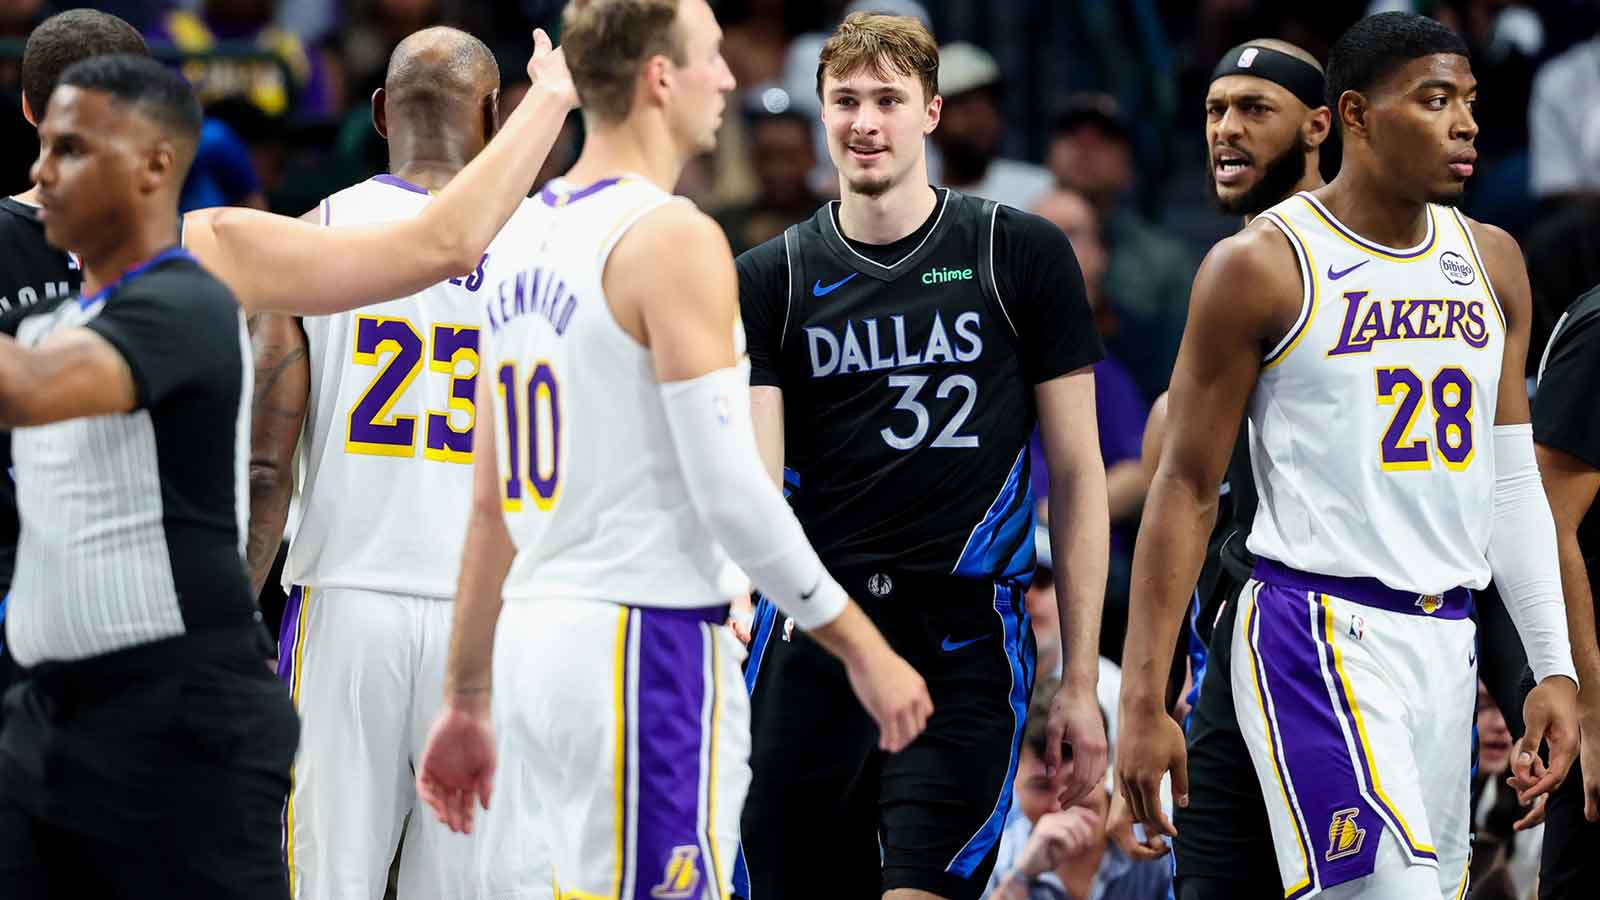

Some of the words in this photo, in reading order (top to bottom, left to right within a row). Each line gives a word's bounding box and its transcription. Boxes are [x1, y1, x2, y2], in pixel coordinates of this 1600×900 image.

[921, 267, 974, 284] chime
[1442, 259, 1472, 277] bibigo
[805, 310, 984, 378] DALLAS
[1326, 290, 1489, 359] LAKERS
[344, 314, 481, 464] 23
[880, 374, 980, 449] 32
[1374, 365, 1476, 472] 28
[497, 359, 563, 512] 10
